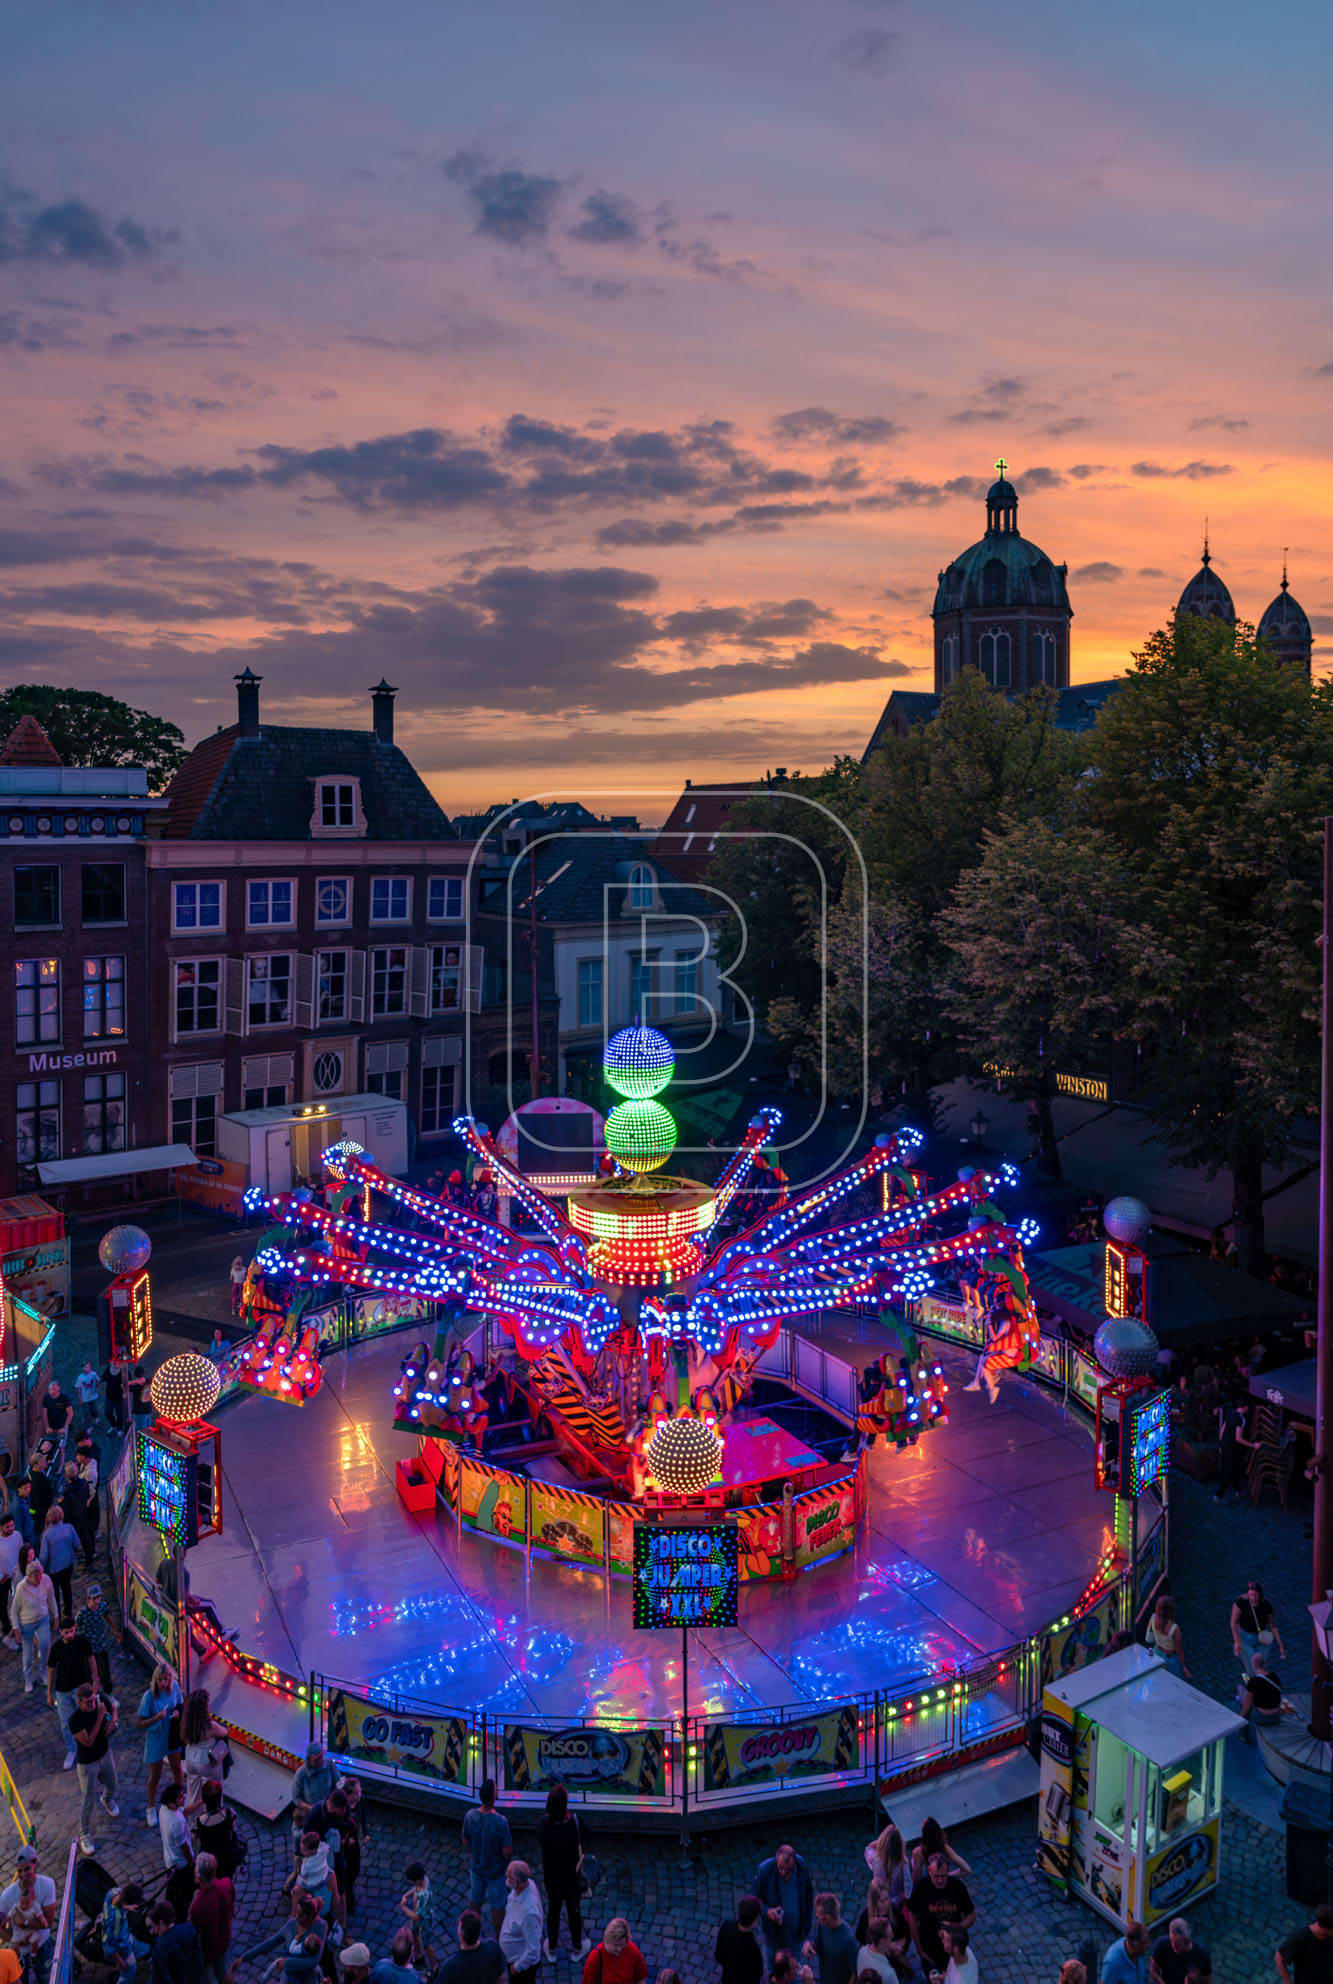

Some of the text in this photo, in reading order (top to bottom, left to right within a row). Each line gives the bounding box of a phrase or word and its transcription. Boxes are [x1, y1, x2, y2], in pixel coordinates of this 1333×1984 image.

[29, 1050, 117, 1072] Museum
[1055, 1072, 1108, 1101] WINSTON
[806, 1501, 839, 1535] DISCO
[659, 1534, 712, 1558] DISCO
[809, 1518, 841, 1552] FEVER
[648, 1563, 722, 1587] JUMPER
[670, 1593, 702, 1617] XXL
[362, 1716, 434, 1749] GO FAST
[741, 1725, 818, 1763] GROOVY
[540, 1739, 590, 1757] DISCO
[1151, 1854, 1185, 1888] DISCO
